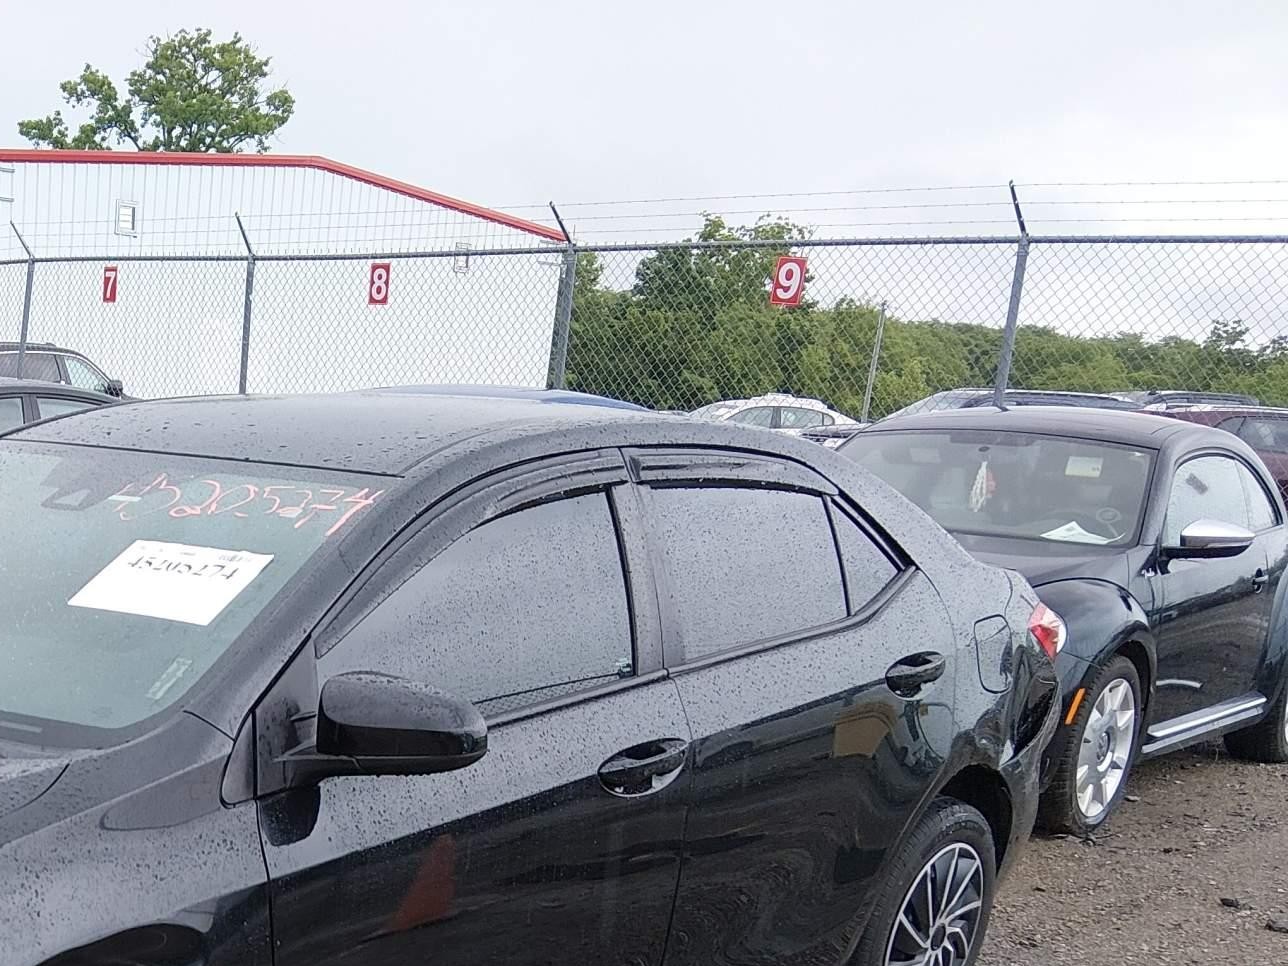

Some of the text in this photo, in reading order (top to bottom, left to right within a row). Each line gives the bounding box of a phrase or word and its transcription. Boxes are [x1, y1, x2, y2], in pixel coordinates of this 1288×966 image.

[104, 270, 116, 299] 7
[371, 267, 387, 300] 8
[776, 262, 801, 300] 9
